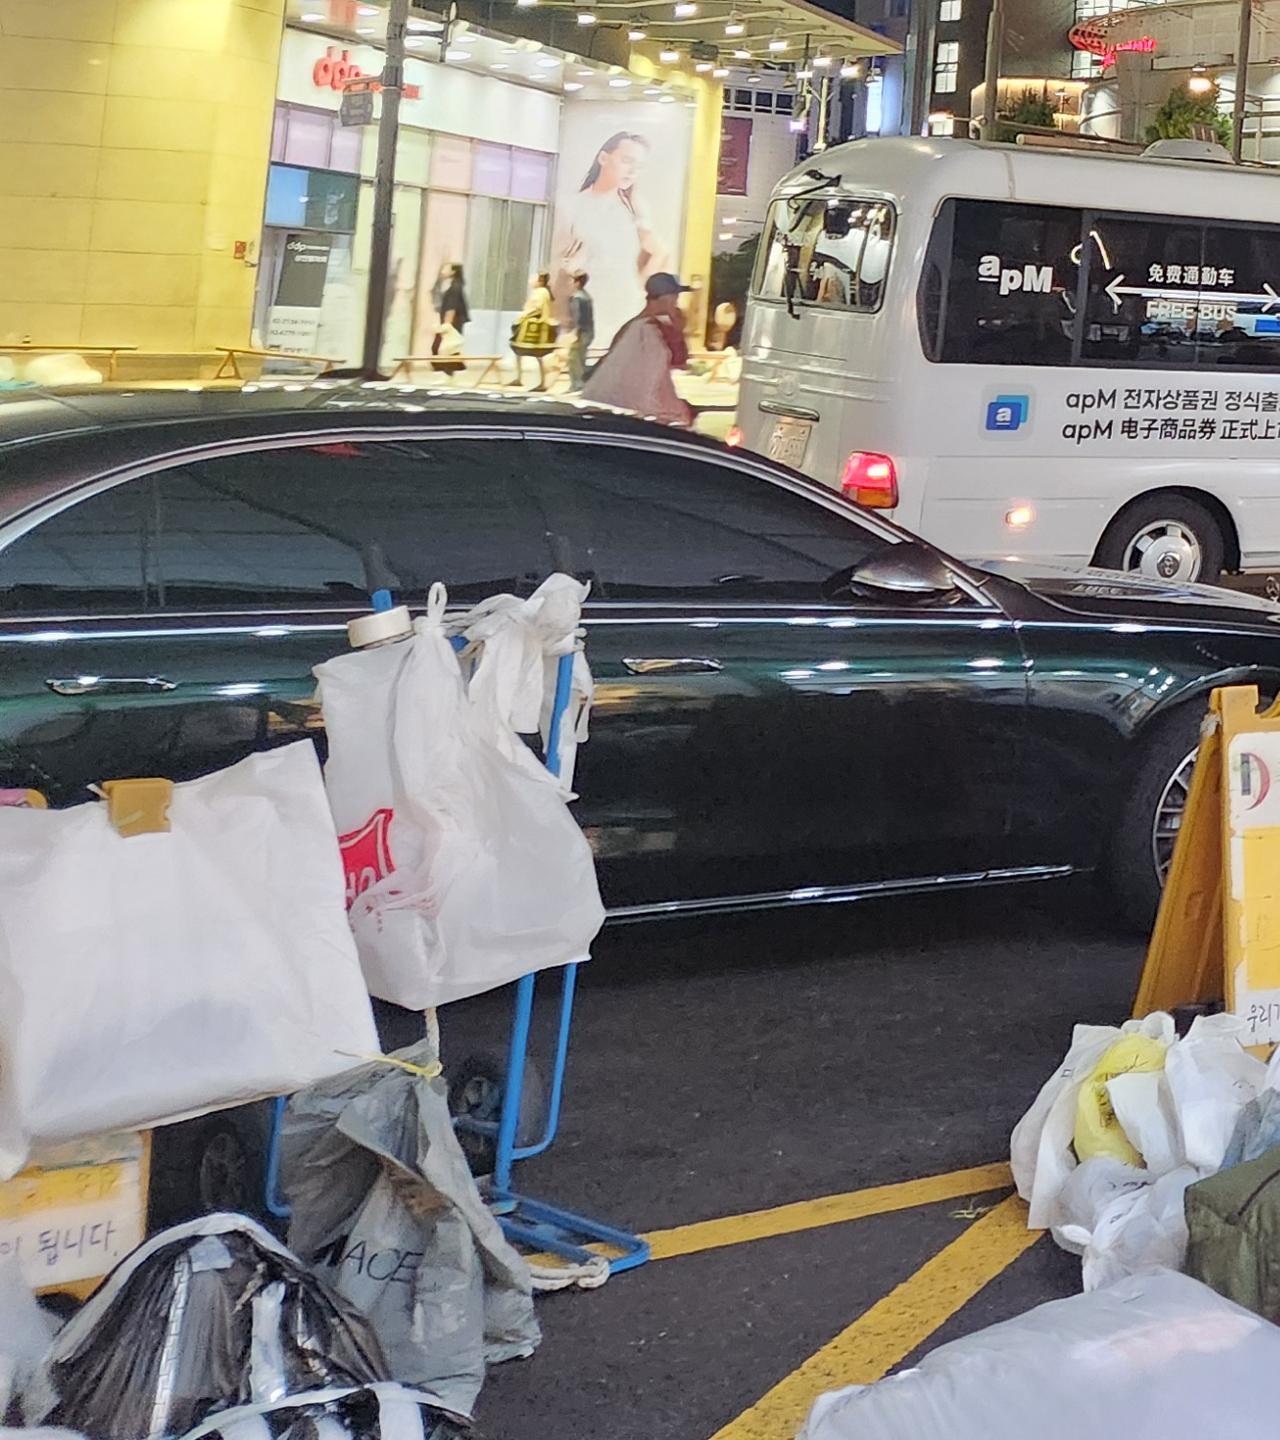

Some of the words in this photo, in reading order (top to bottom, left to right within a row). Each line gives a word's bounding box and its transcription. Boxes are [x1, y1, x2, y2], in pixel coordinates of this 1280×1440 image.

[978, 254, 1053, 296] apM
[1148, 263, 1235, 287] 免费通勤车
[1146, 301, 1195, 319] FREE
[1200, 303, 1239, 322] BUS
[1066, 389, 1117, 413] apM
[1123, 389, 1218, 411] 전자상품권
[1062, 420, 1113, 444] apM
[1120, 418, 1217, 441] 电子商品券
